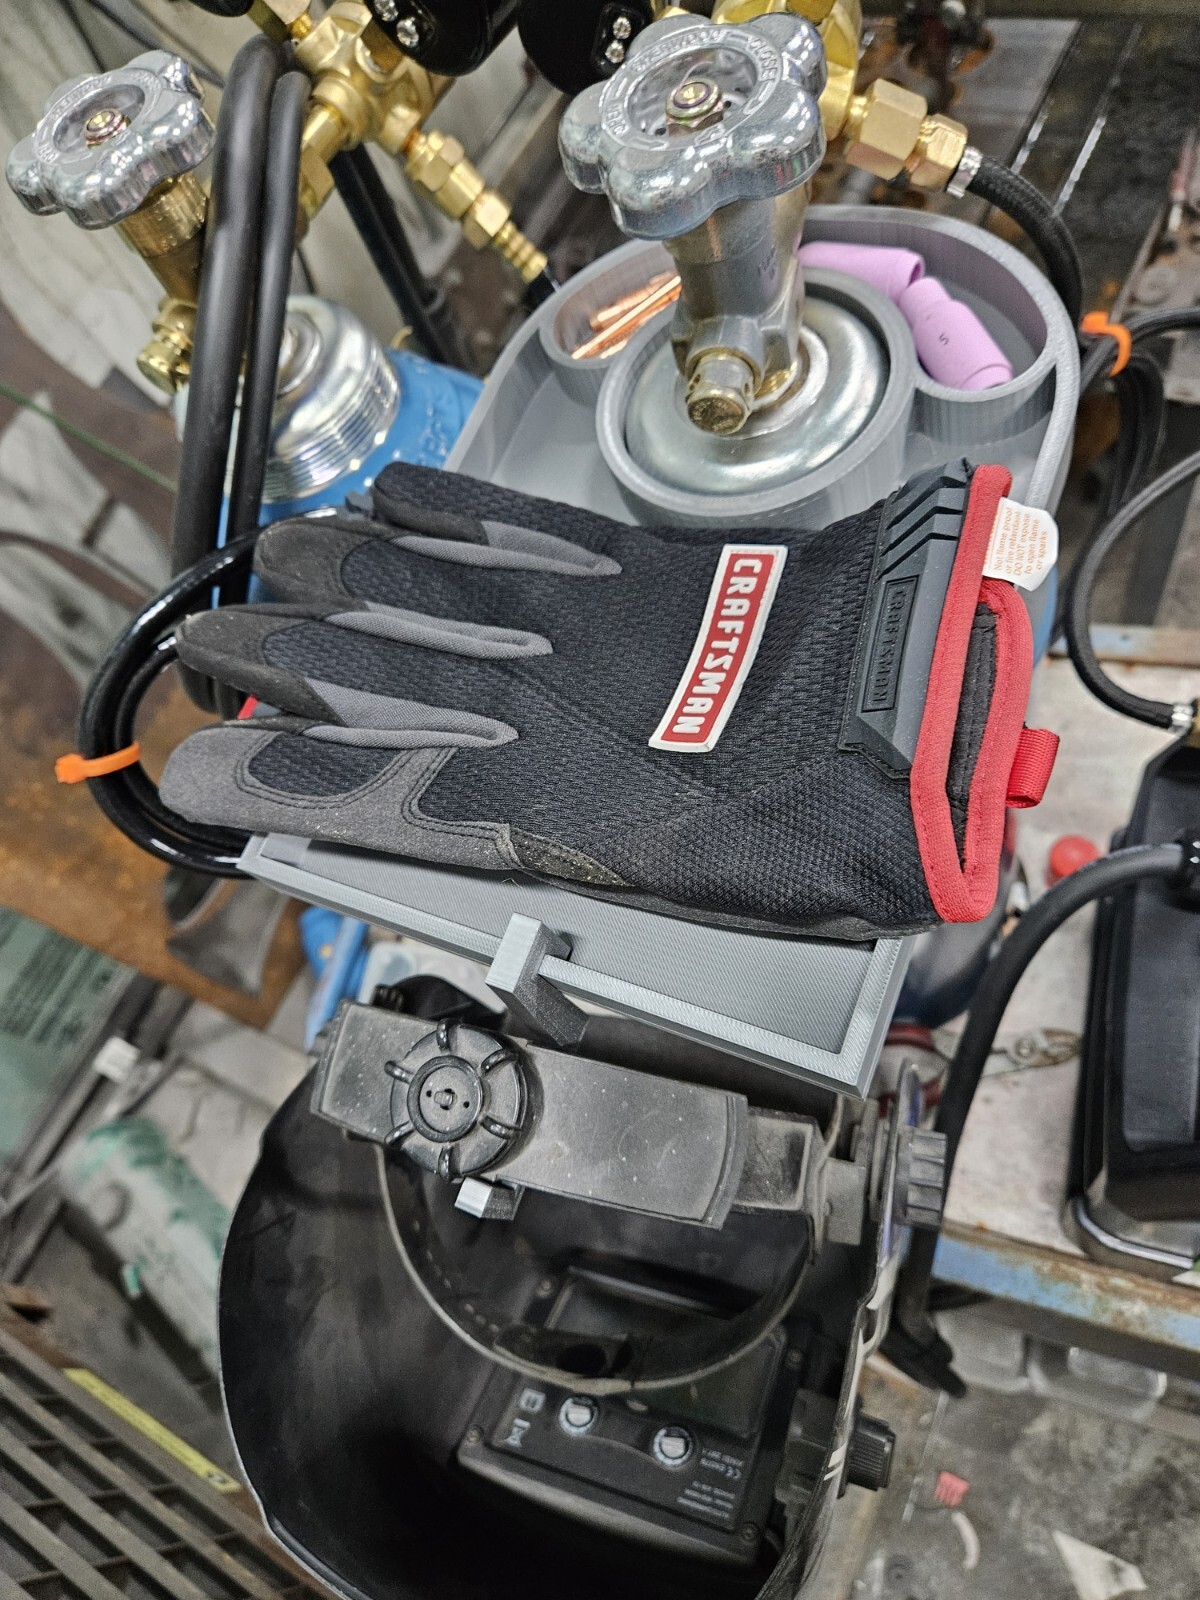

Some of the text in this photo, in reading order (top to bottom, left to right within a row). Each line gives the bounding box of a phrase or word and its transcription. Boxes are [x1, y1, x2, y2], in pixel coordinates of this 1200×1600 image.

[749, 36, 779, 81] CLOSE
[993, 507, 1012, 571] Not flame proof
[1013, 512, 1031, 576] DO NOT expose
[1027, 543, 1035, 564] open
[1028, 519, 1040, 542] flame
[671, 558, 763, 735] CRAFTSMAN
[872, 590, 907, 702] CRAFTSMAN
